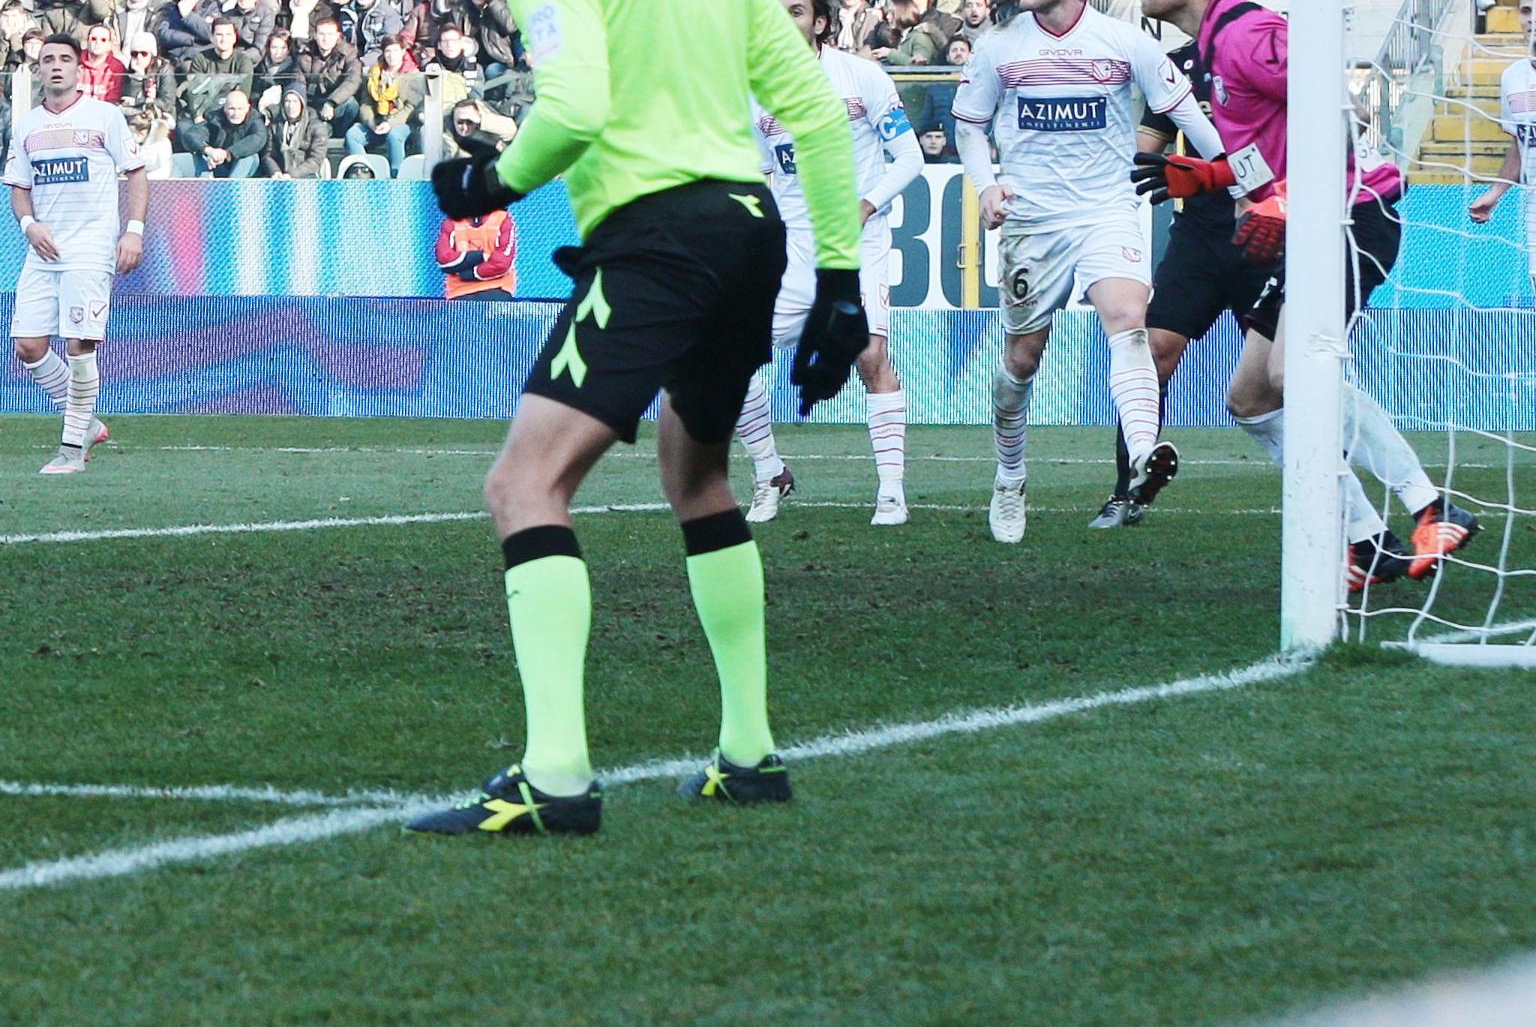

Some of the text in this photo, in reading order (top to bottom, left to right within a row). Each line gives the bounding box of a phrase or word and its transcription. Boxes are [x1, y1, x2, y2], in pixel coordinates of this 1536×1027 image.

[1020, 101, 1099, 121] AZIMUT
[877, 114, 898, 141] C
[1013, 267, 1029, 300] 6
